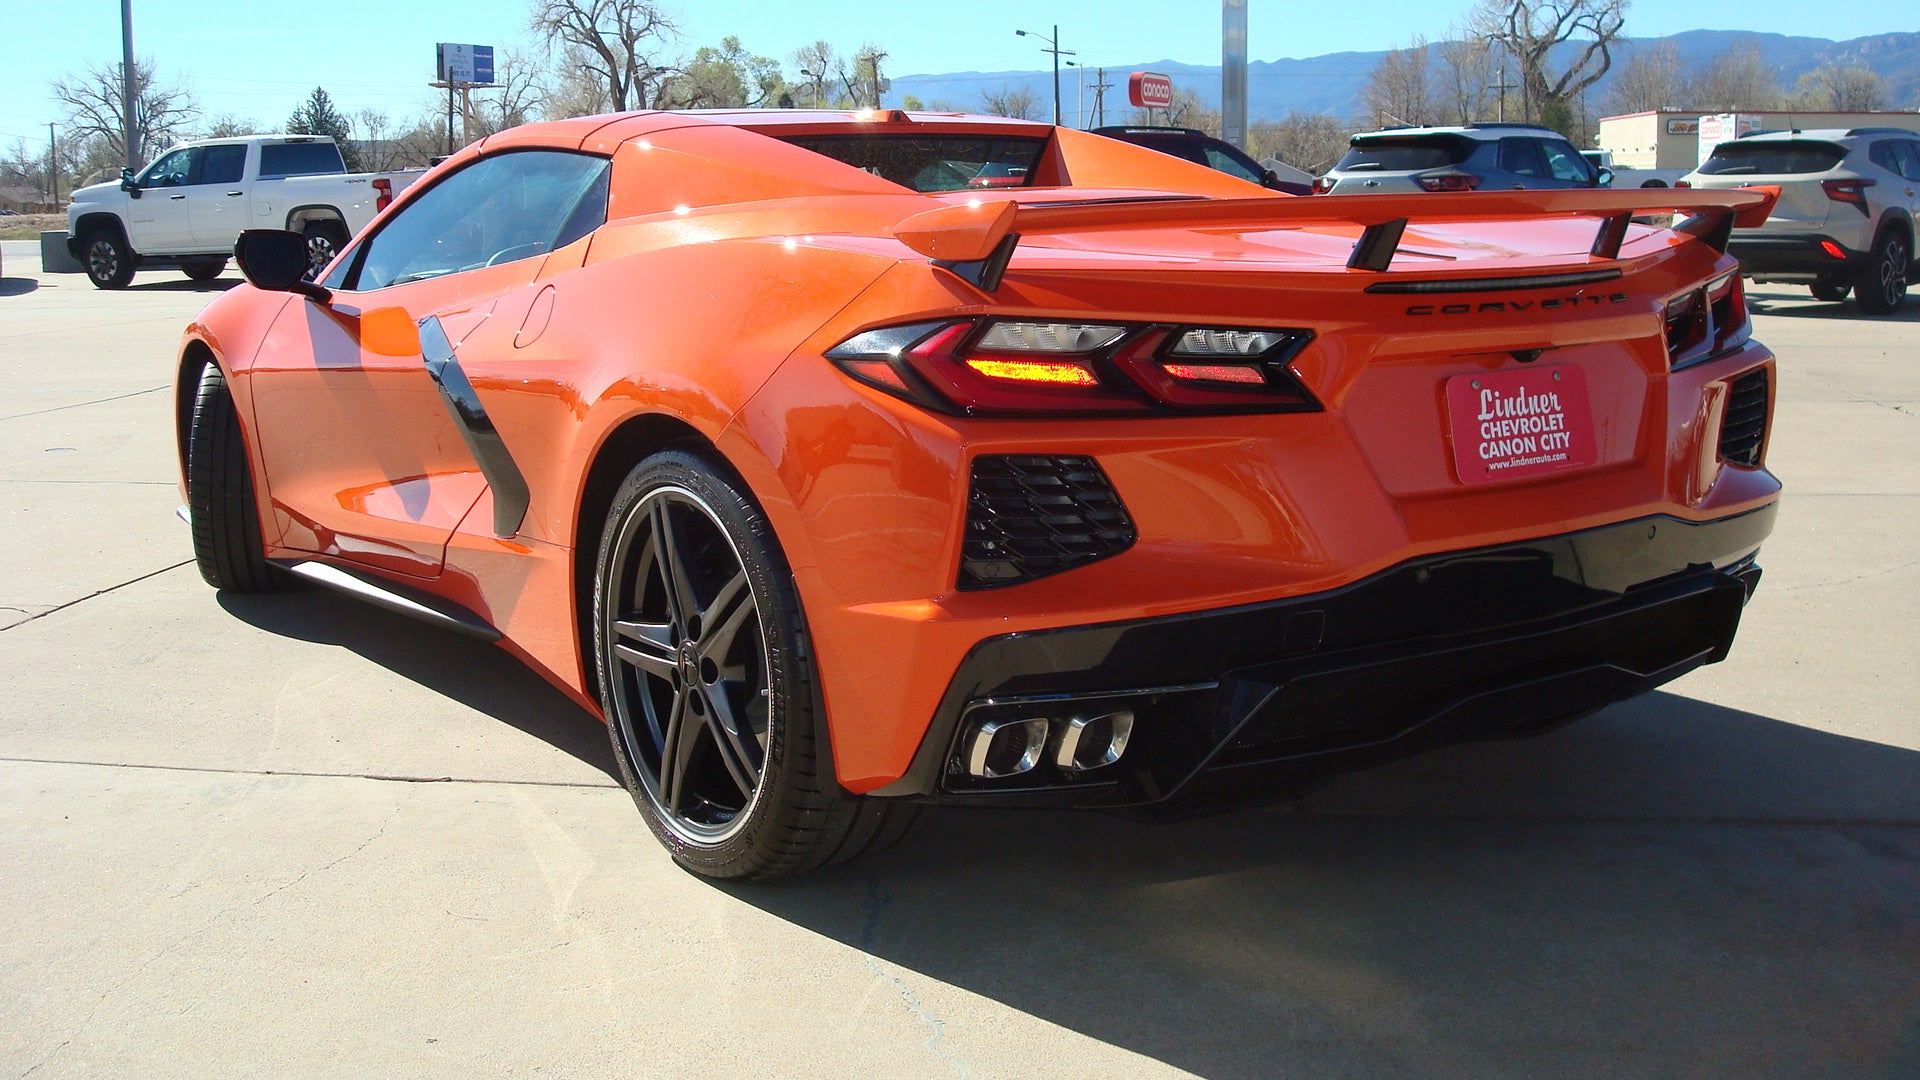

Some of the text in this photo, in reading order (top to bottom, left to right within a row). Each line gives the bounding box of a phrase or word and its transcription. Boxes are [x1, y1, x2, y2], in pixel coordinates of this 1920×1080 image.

[1406, 293, 1628, 316] CORVETTE
[1478, 386, 1561, 420] Lindner
[1480, 413, 1565, 440] CHEVROLET
[1479, 431, 1571, 460] CANON CITY
[1488, 452, 1567, 471] www.lindnerauto.com
